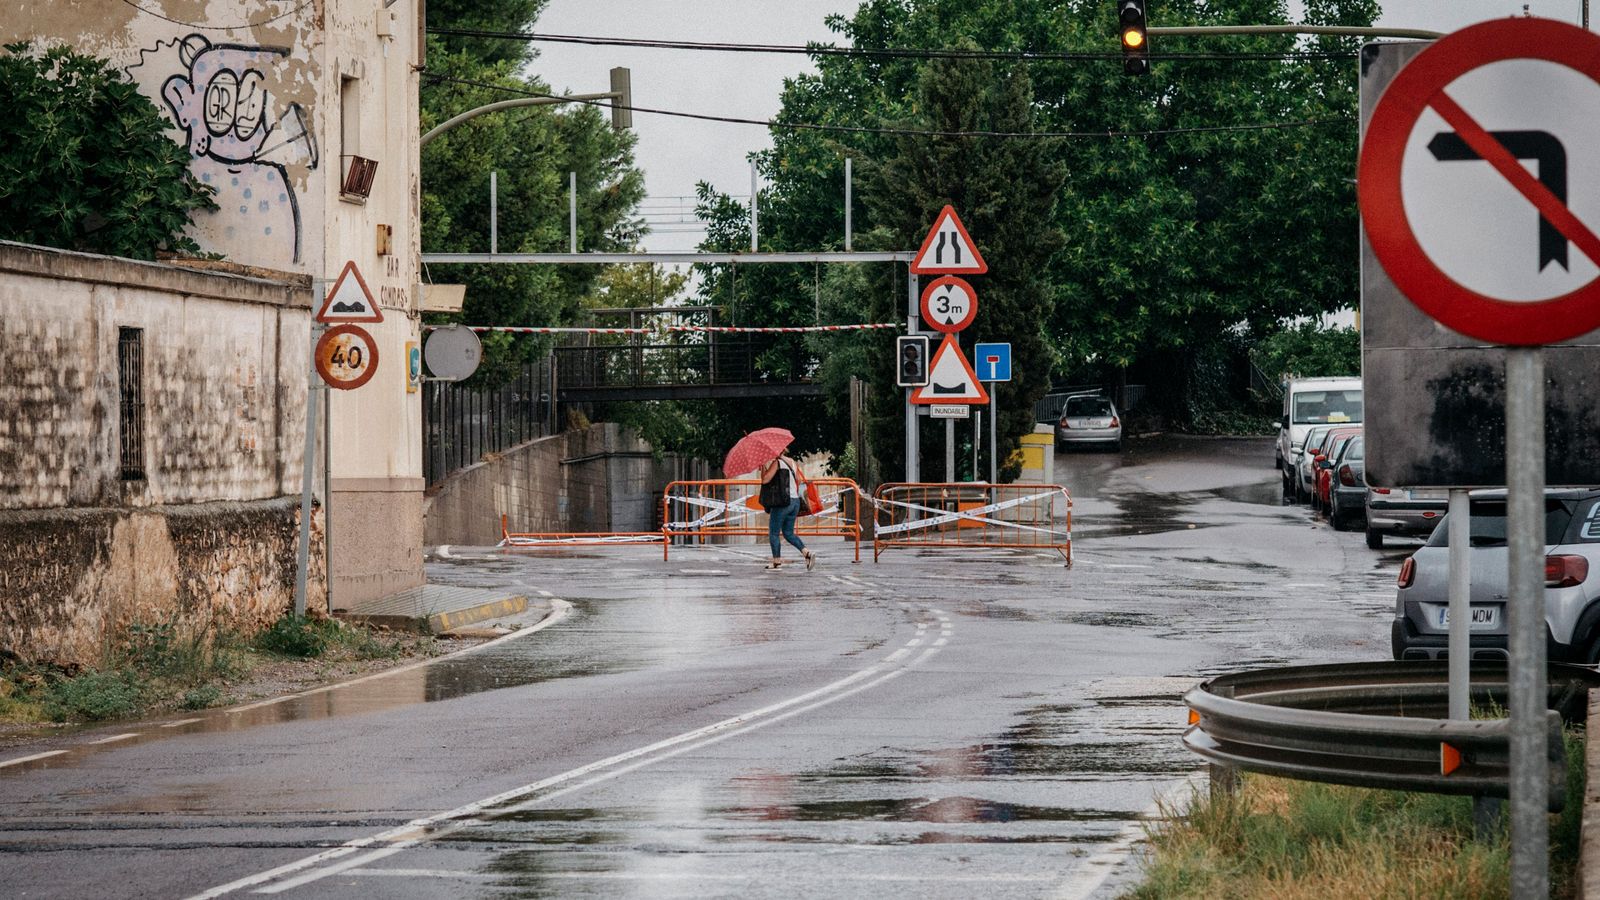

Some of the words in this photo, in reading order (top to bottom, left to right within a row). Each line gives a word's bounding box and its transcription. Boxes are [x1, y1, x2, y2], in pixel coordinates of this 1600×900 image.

[387, 256, 400, 278] BAR
[330, 344, 363, 369] 40
[934, 407, 967, 415] INUNDABLE
